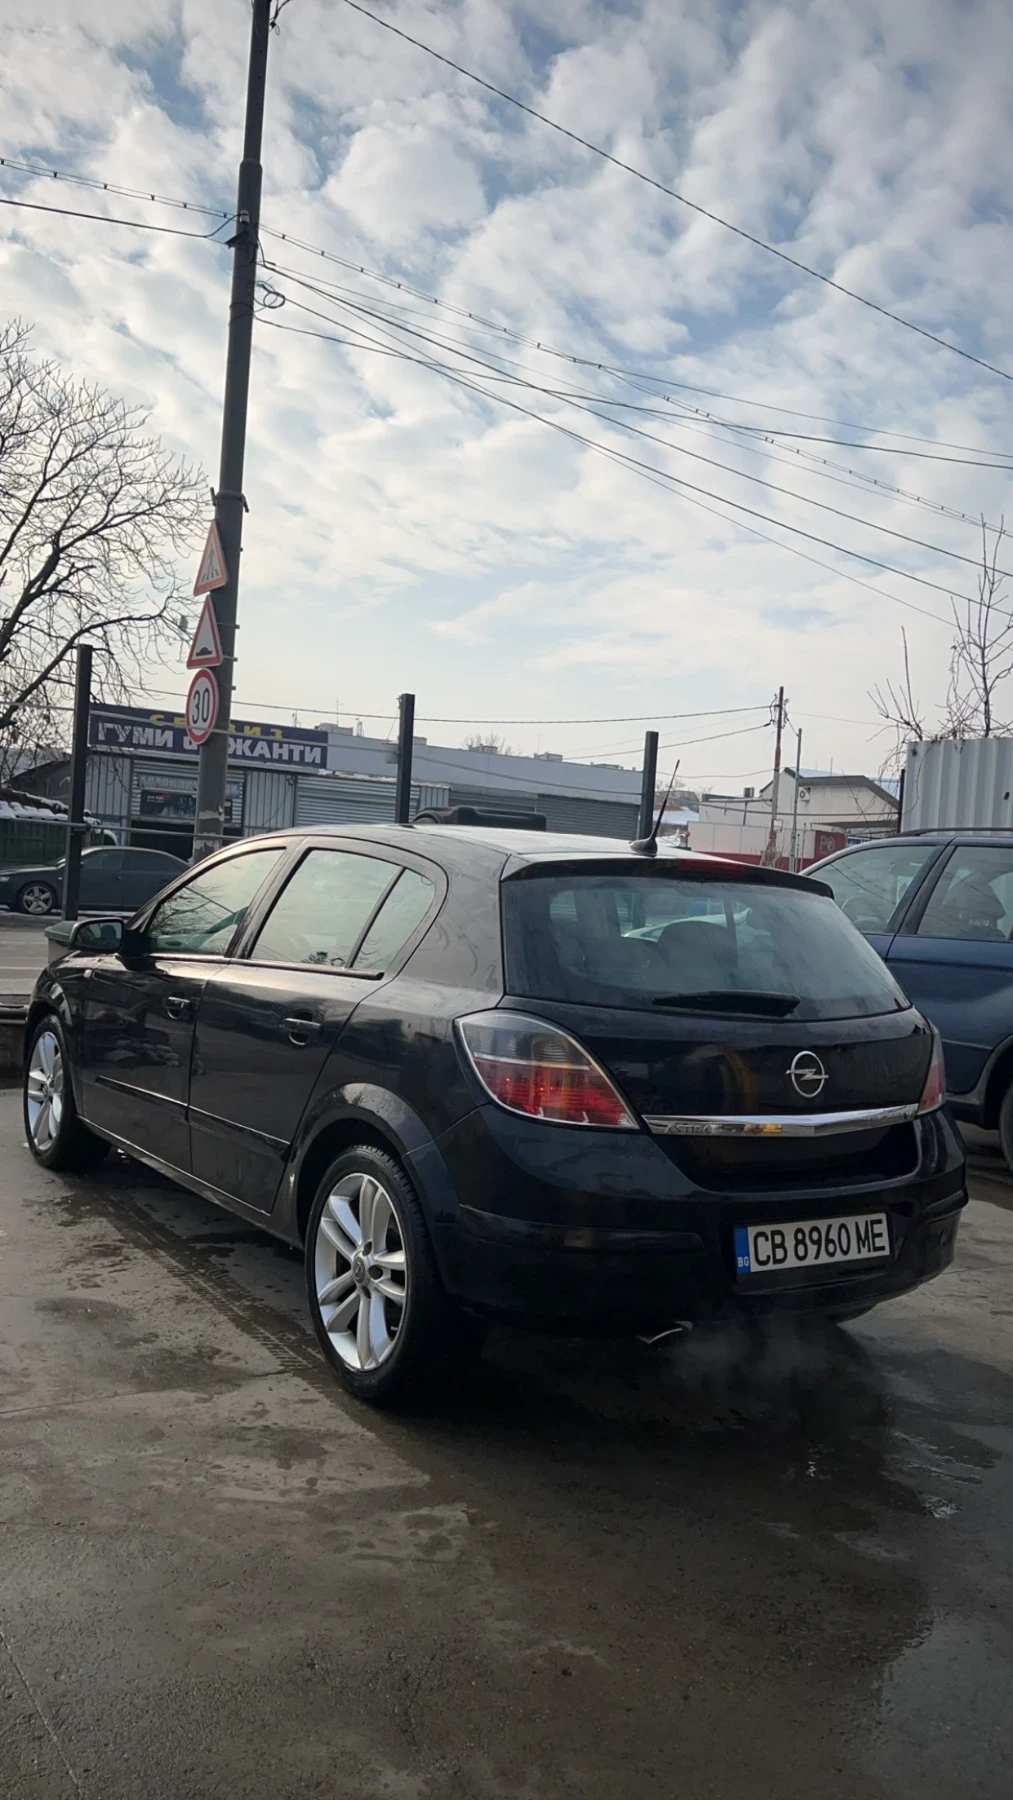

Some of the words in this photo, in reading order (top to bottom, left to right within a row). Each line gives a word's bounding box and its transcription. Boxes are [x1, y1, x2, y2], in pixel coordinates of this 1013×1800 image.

[191, 687, 210, 725] 30
[97, 721, 174, 748] ГУМИ
[227, 737, 322, 764] ЖАНТИ
[737, 1256, 750, 1268] BG
[753, 1229, 788, 1267] CB
[793, 1222, 852, 1262] 8960
[855, 1218, 886, 1255] ME
